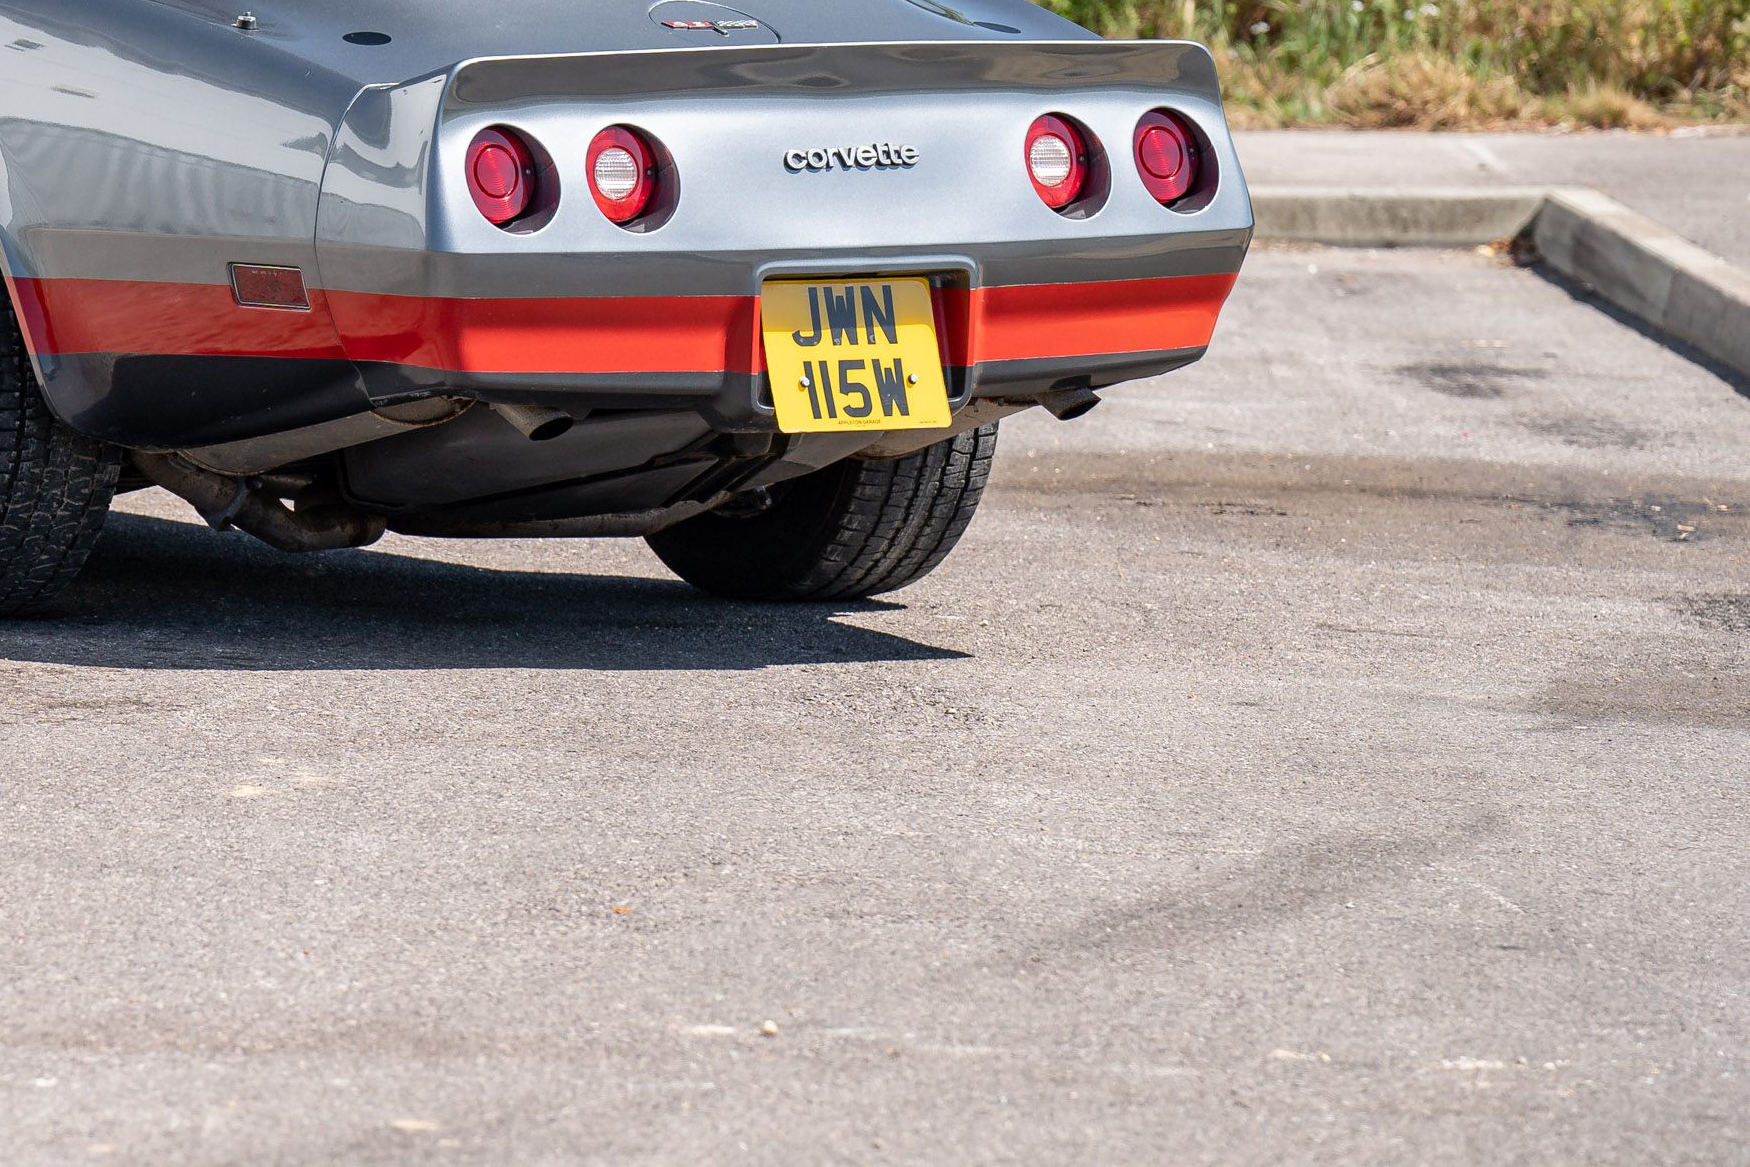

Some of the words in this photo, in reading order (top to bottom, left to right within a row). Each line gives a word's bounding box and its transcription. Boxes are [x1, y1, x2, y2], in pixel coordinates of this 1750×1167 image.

[784, 142, 920, 170] corvette
[791, 284, 898, 347] JWN
[802, 357, 910, 420] 115W
